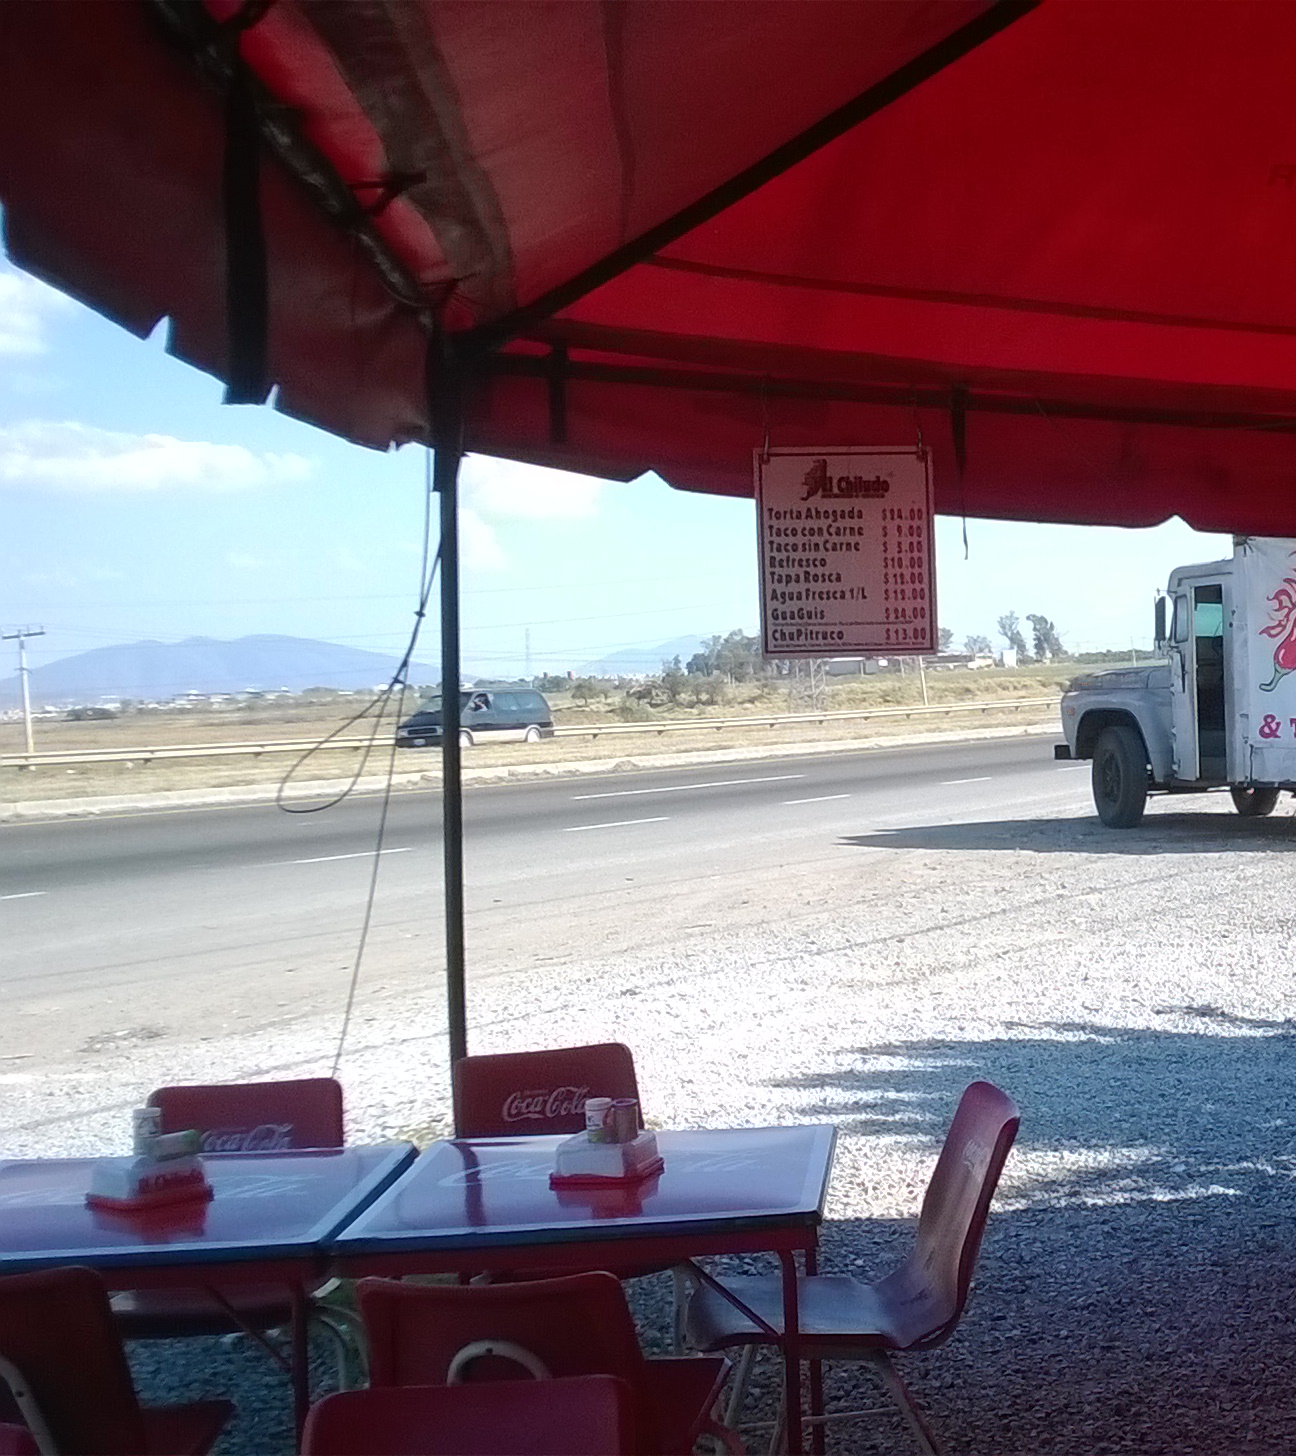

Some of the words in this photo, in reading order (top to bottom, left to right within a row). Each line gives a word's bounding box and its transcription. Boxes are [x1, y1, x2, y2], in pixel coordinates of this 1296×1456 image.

[767, 508, 802, 521] Torta
[805, 507, 863, 523] Ahogada
[768, 525, 798, 538] Taco
[801, 527, 824, 538] con
[826, 524, 864, 538] Carne
[768, 540, 798, 553] Taco
[801, 539, 821, 552] sin
[822, 539, 861, 552] Carne
[769, 556, 827, 569] Refresco
[769, 571, 801, 587] Tapa
[803, 570, 842, 584] Rosca
[770, 588, 803, 604] Agua
[805, 587, 846, 601] Fresca
[772, 628, 844, 642] ChuPitruco
[1258, 713, 1281, 739] &
